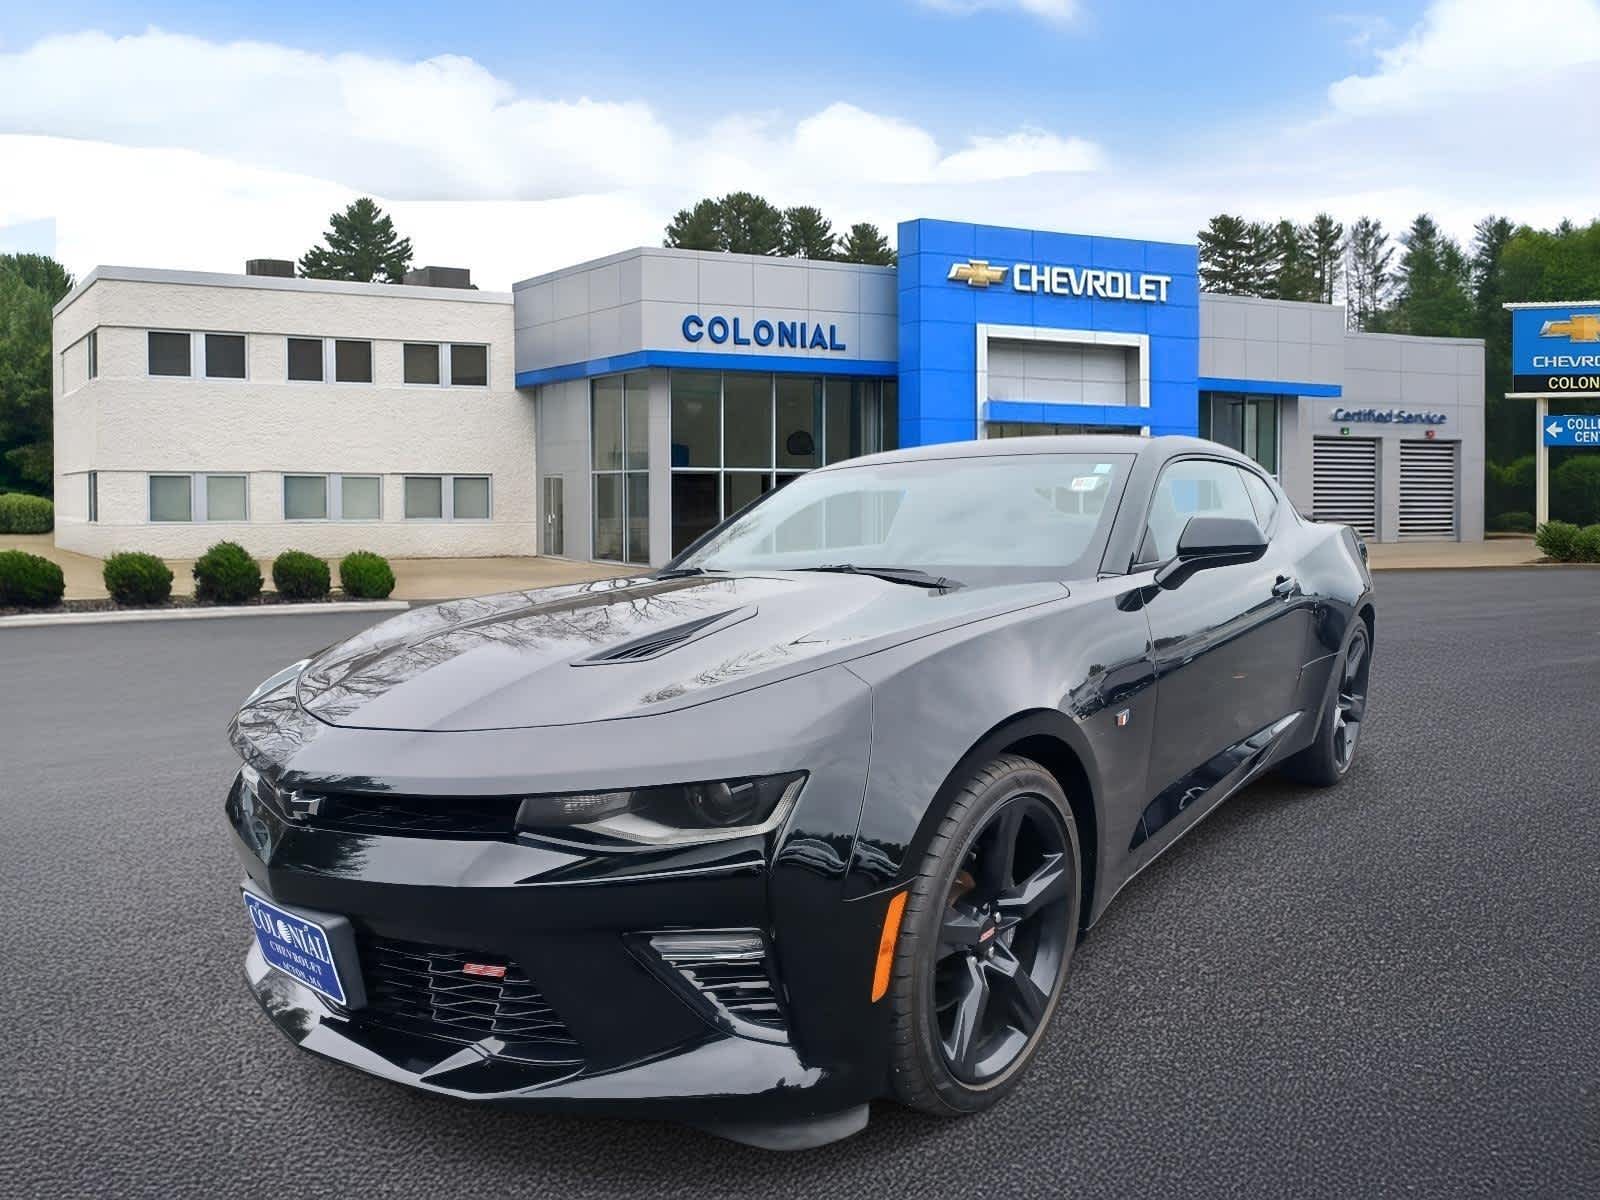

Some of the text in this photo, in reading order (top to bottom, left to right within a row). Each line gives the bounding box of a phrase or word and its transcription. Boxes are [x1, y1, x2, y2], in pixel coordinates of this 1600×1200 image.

[1012, 262, 1172, 303] CHEVROLET
[682, 314, 847, 351] COLONIAL
[1548, 376, 1600, 389] COLON
[1332, 408, 1447, 425] Certified Service
[1575, 431, 1600, 443] CEN
[249, 904, 331, 964] COLONIAL
[269, 940, 322, 976] CHEVROLET
